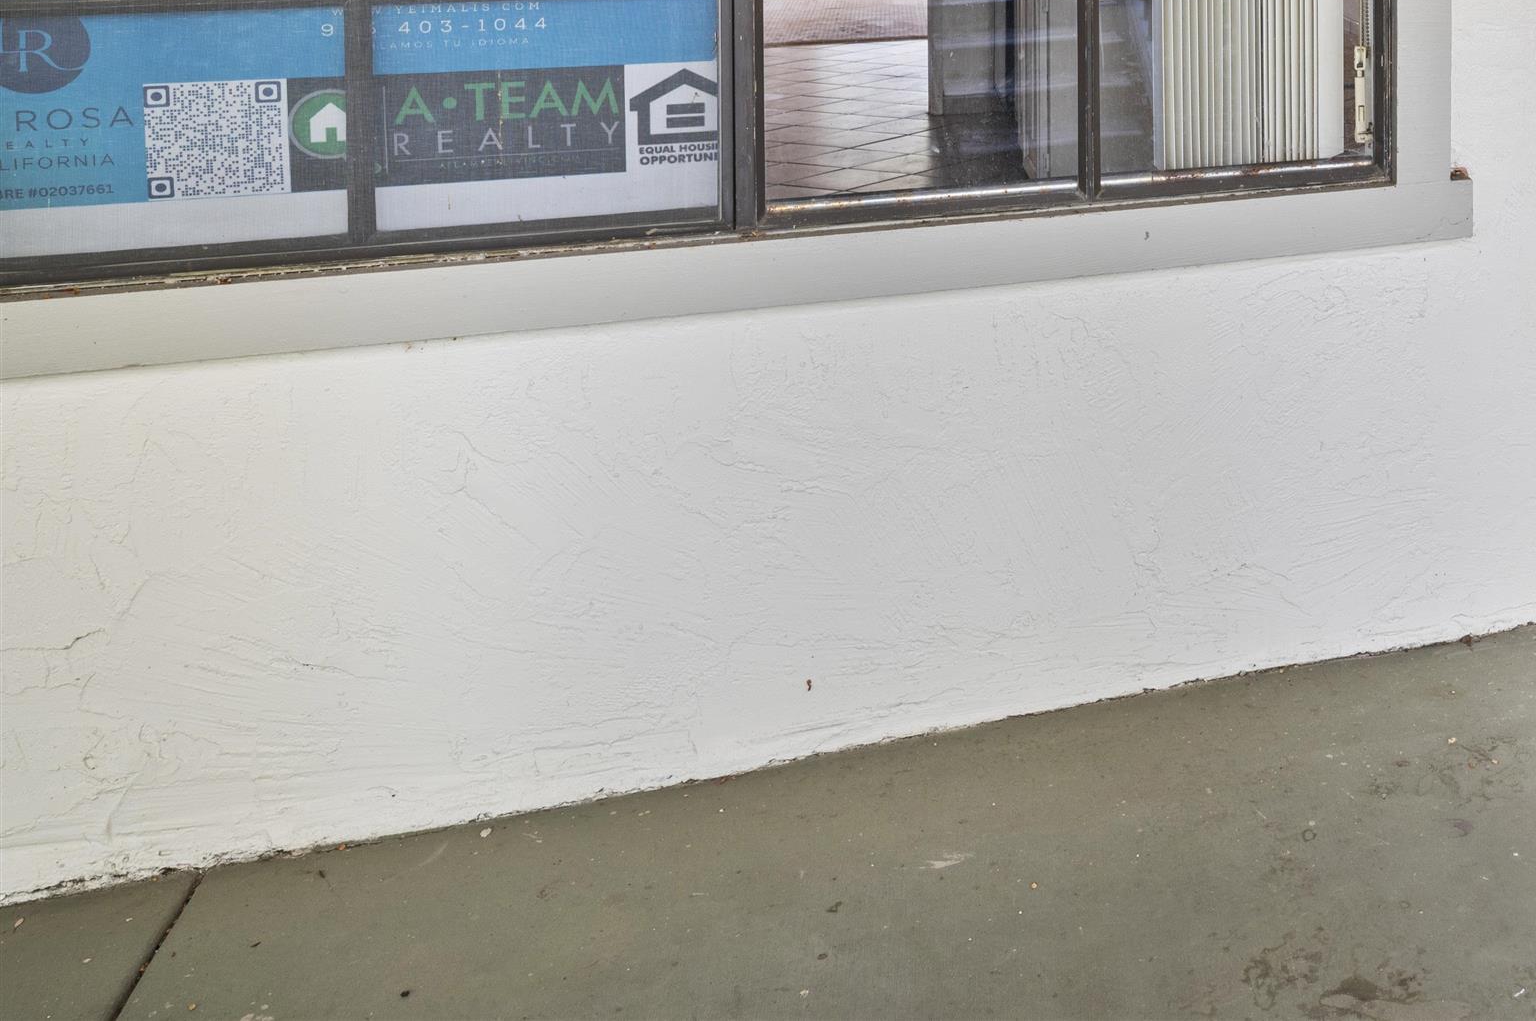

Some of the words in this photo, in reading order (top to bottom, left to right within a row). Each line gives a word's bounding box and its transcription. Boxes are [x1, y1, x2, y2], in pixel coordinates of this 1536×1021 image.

[16, 106, 134, 131] ROSA
[393, 120, 621, 156] REALTY
[638, 145, 676, 155] EQUAL
[639, 152, 718, 166] OPPORTUNI
[28, 183, 114, 198] #02037661
